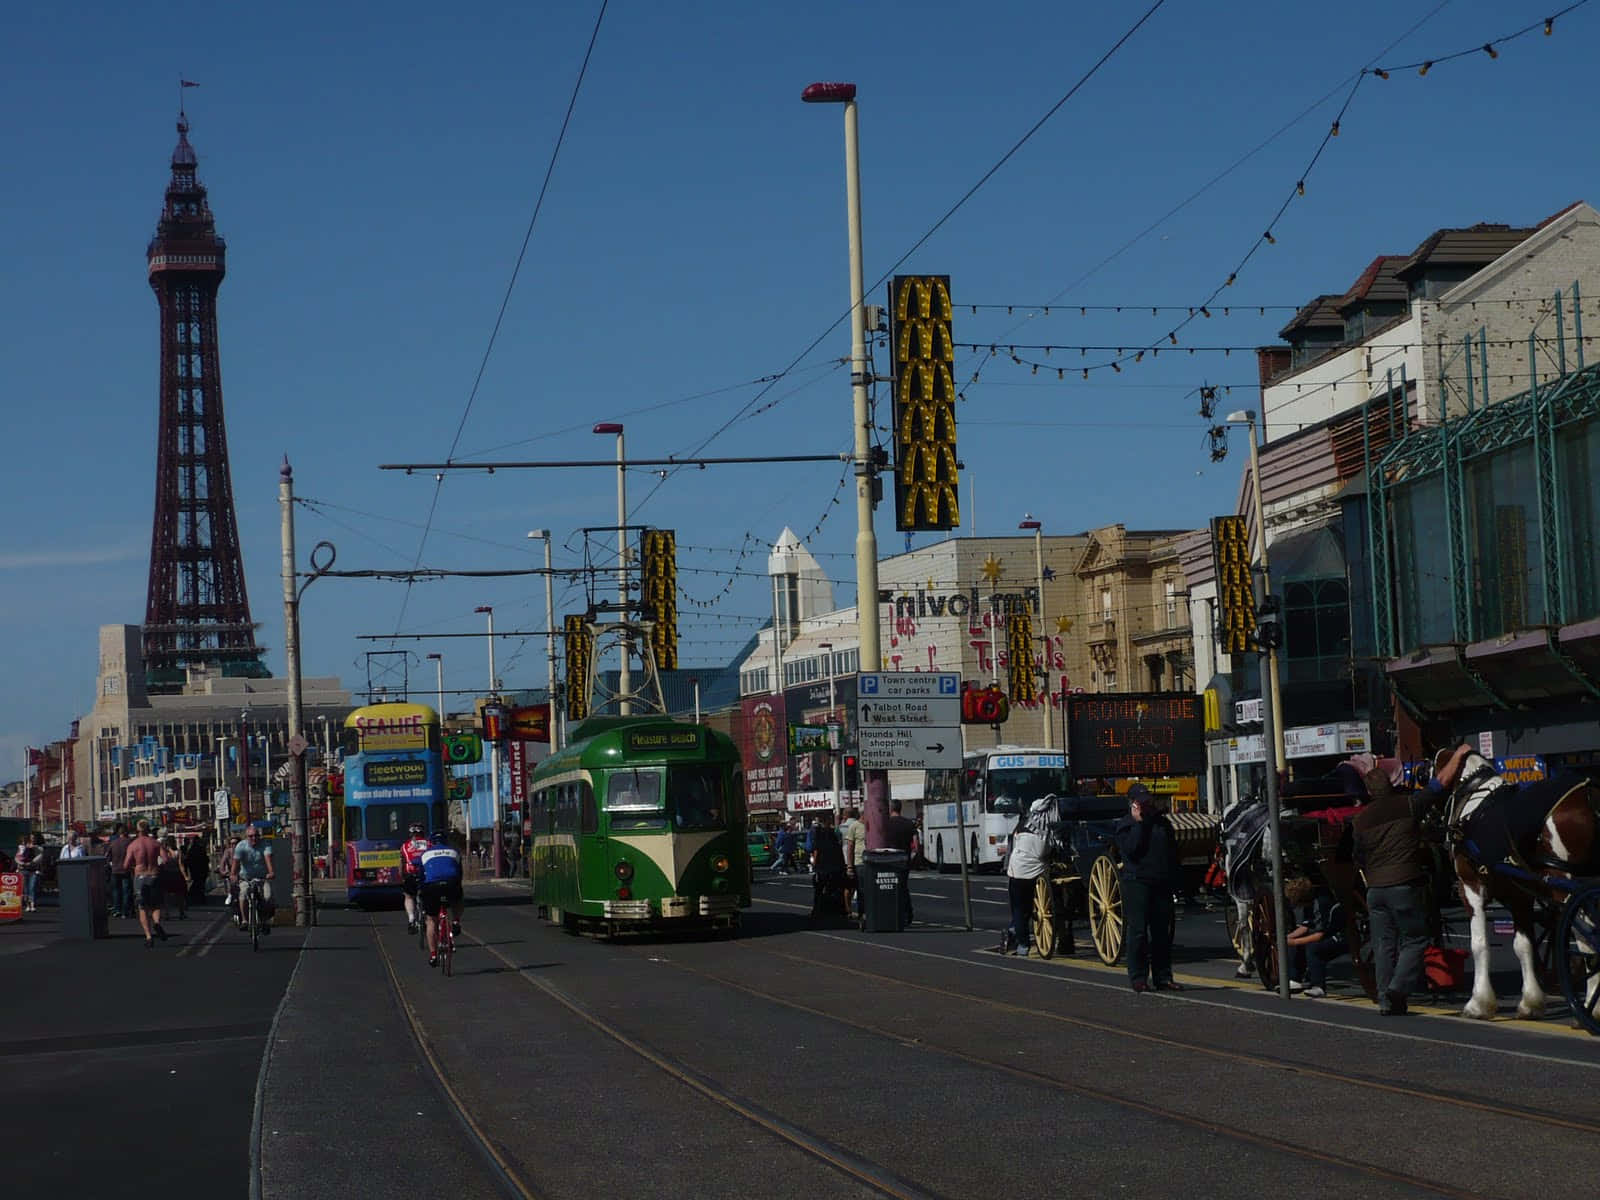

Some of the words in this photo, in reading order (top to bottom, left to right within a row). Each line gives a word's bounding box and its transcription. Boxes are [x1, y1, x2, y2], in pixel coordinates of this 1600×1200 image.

[882, 676, 905, 684] Town
[909, 676, 936, 684] centre
[905, 687, 930, 695] parks
[873, 703, 902, 711] Talbot
[905, 703, 928, 711] Road
[872, 714, 896, 722] West
[899, 714, 928, 722] Street
[390, 715, 422, 735] LIFE
[861, 730, 893, 738] Hounds
[897, 730, 912, 738] Hill
[861, 749, 894, 757] Central
[861, 759, 893, 767] Chapel
[897, 759, 925, 767] Street
[997, 757, 1024, 767] GUS
[1039, 757, 1065, 767] BUS
